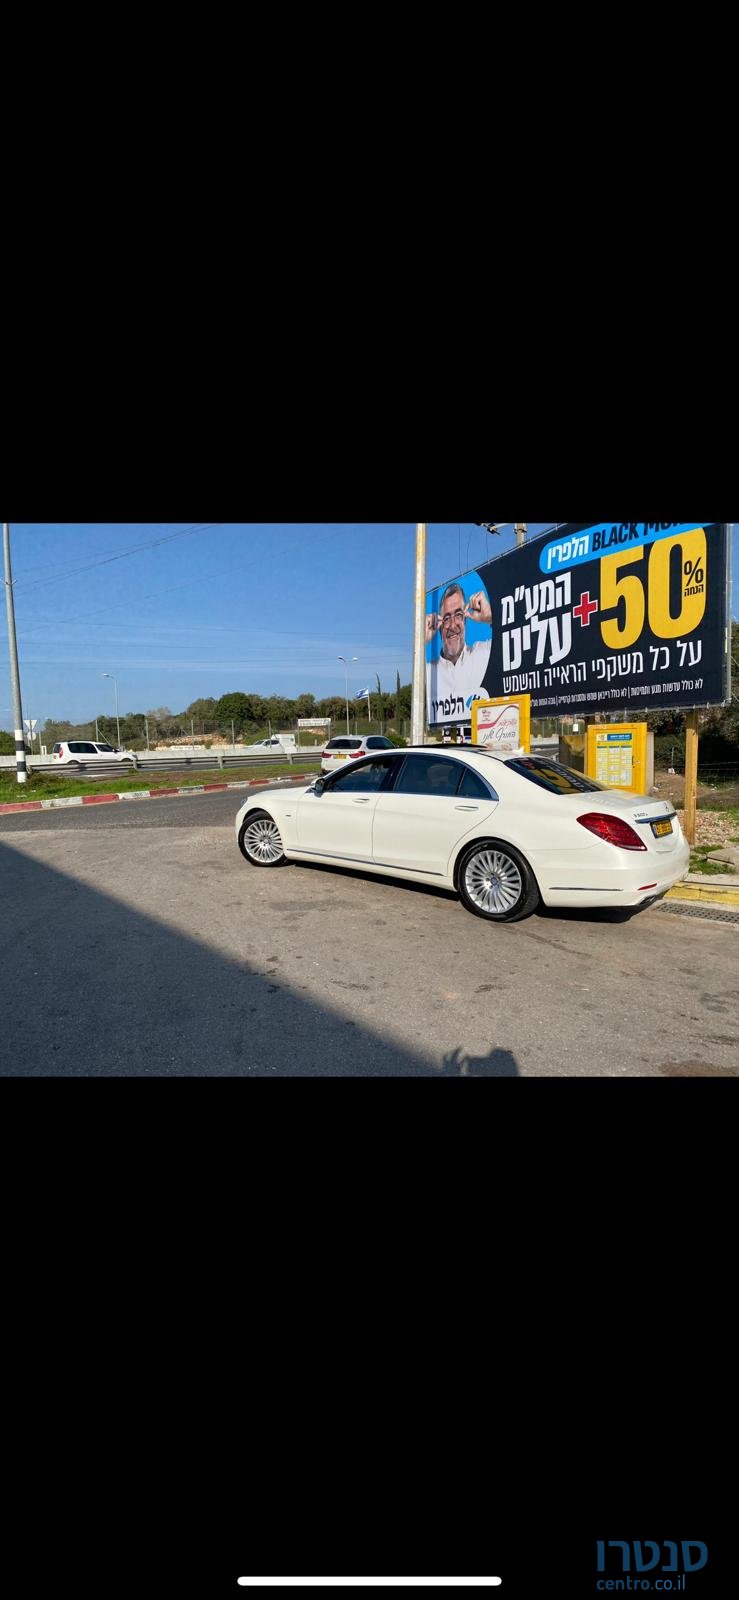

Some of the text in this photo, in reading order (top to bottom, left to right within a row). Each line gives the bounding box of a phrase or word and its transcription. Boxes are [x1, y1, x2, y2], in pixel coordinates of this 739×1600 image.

[592, 523, 639, 552] BLACK
[547, 535, 589, 569] הלפרין
[600, 527, 707, 649] 50
[684, 584, 704, 597] הנחה
[502, 612, 572, 672] עלינו
[503, 640, 702, 694] על כל משקפי הראייה והשמש
[662, 682, 680, 692] עדשות
[681, 680, 694, 691] כולל
[694, 678, 704, 689] לא
[432, 693, 464, 721] הלפרין
